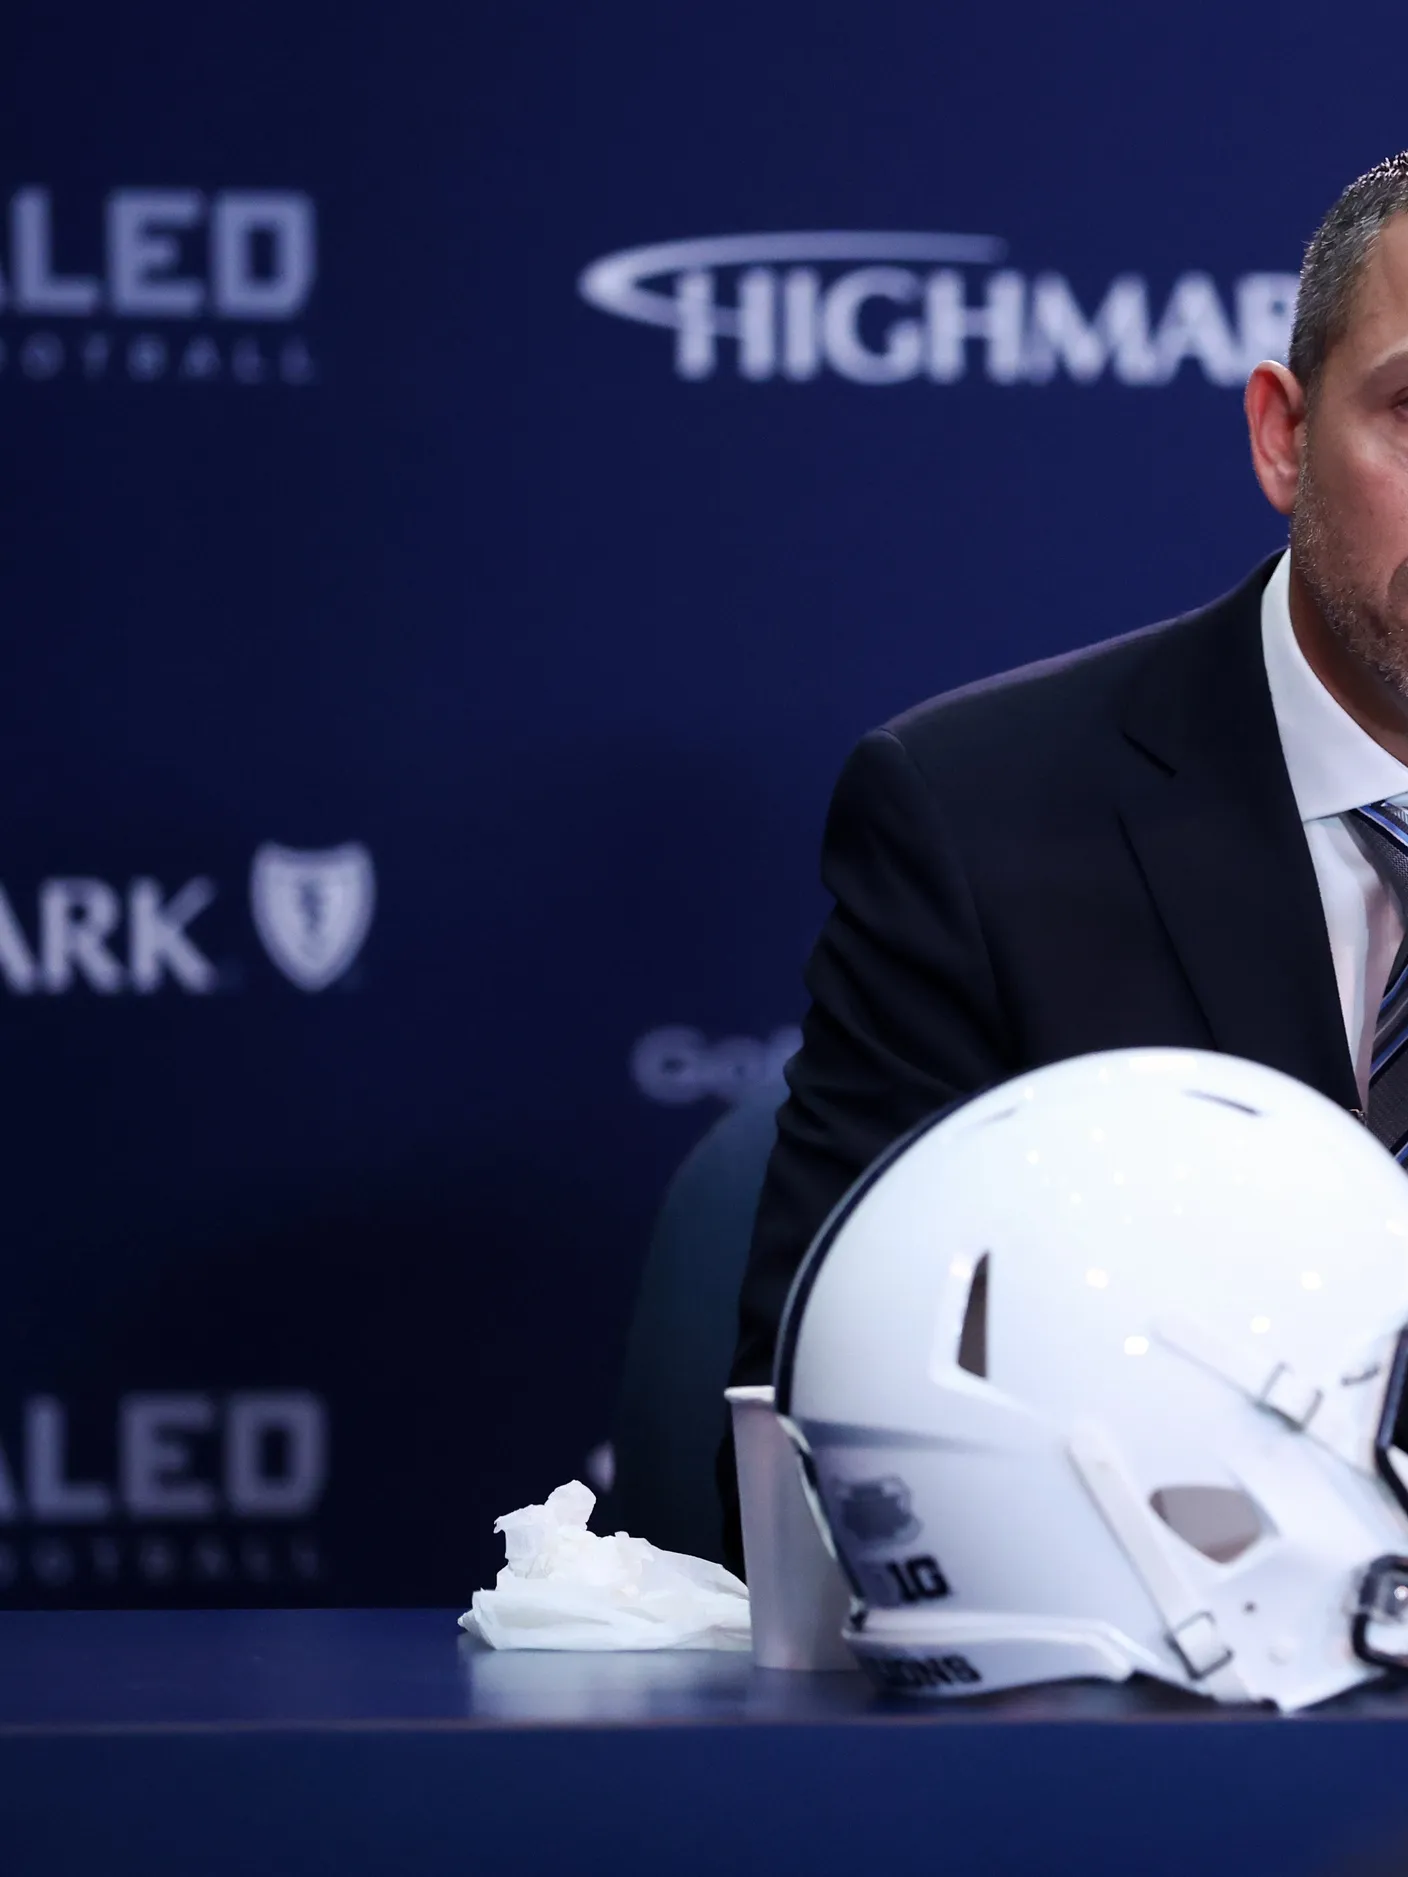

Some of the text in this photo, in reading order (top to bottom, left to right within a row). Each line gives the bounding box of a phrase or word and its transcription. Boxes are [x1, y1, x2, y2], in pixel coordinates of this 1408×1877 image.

[0, 187, 317, 317] LED
[675, 264, 1304, 387] HIGHMAR
[0, 1387, 329, 1521] LED
